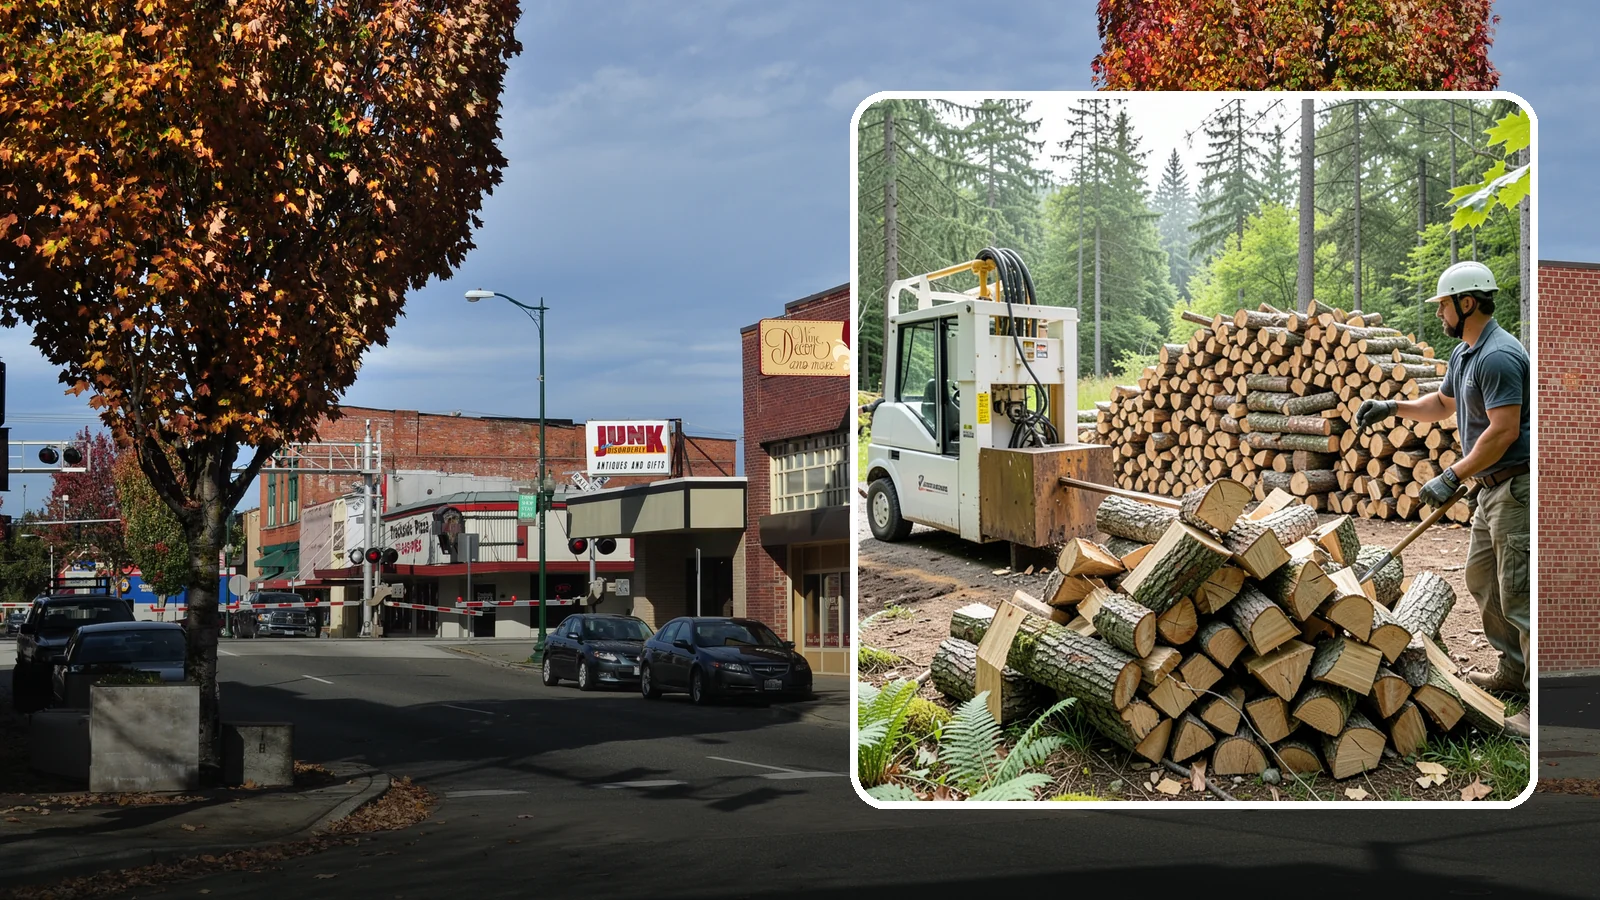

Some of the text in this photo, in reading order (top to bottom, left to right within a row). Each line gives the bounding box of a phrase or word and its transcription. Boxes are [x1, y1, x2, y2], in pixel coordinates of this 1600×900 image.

[595, 425, 665, 457] JUNK
[607, 446, 645, 454] DISORDERLY
[597, 460, 665, 470] ANTIQUES AND GIFTS
[573, 473, 589, 492] RAIL
[415, 519, 429, 535] Pizza
